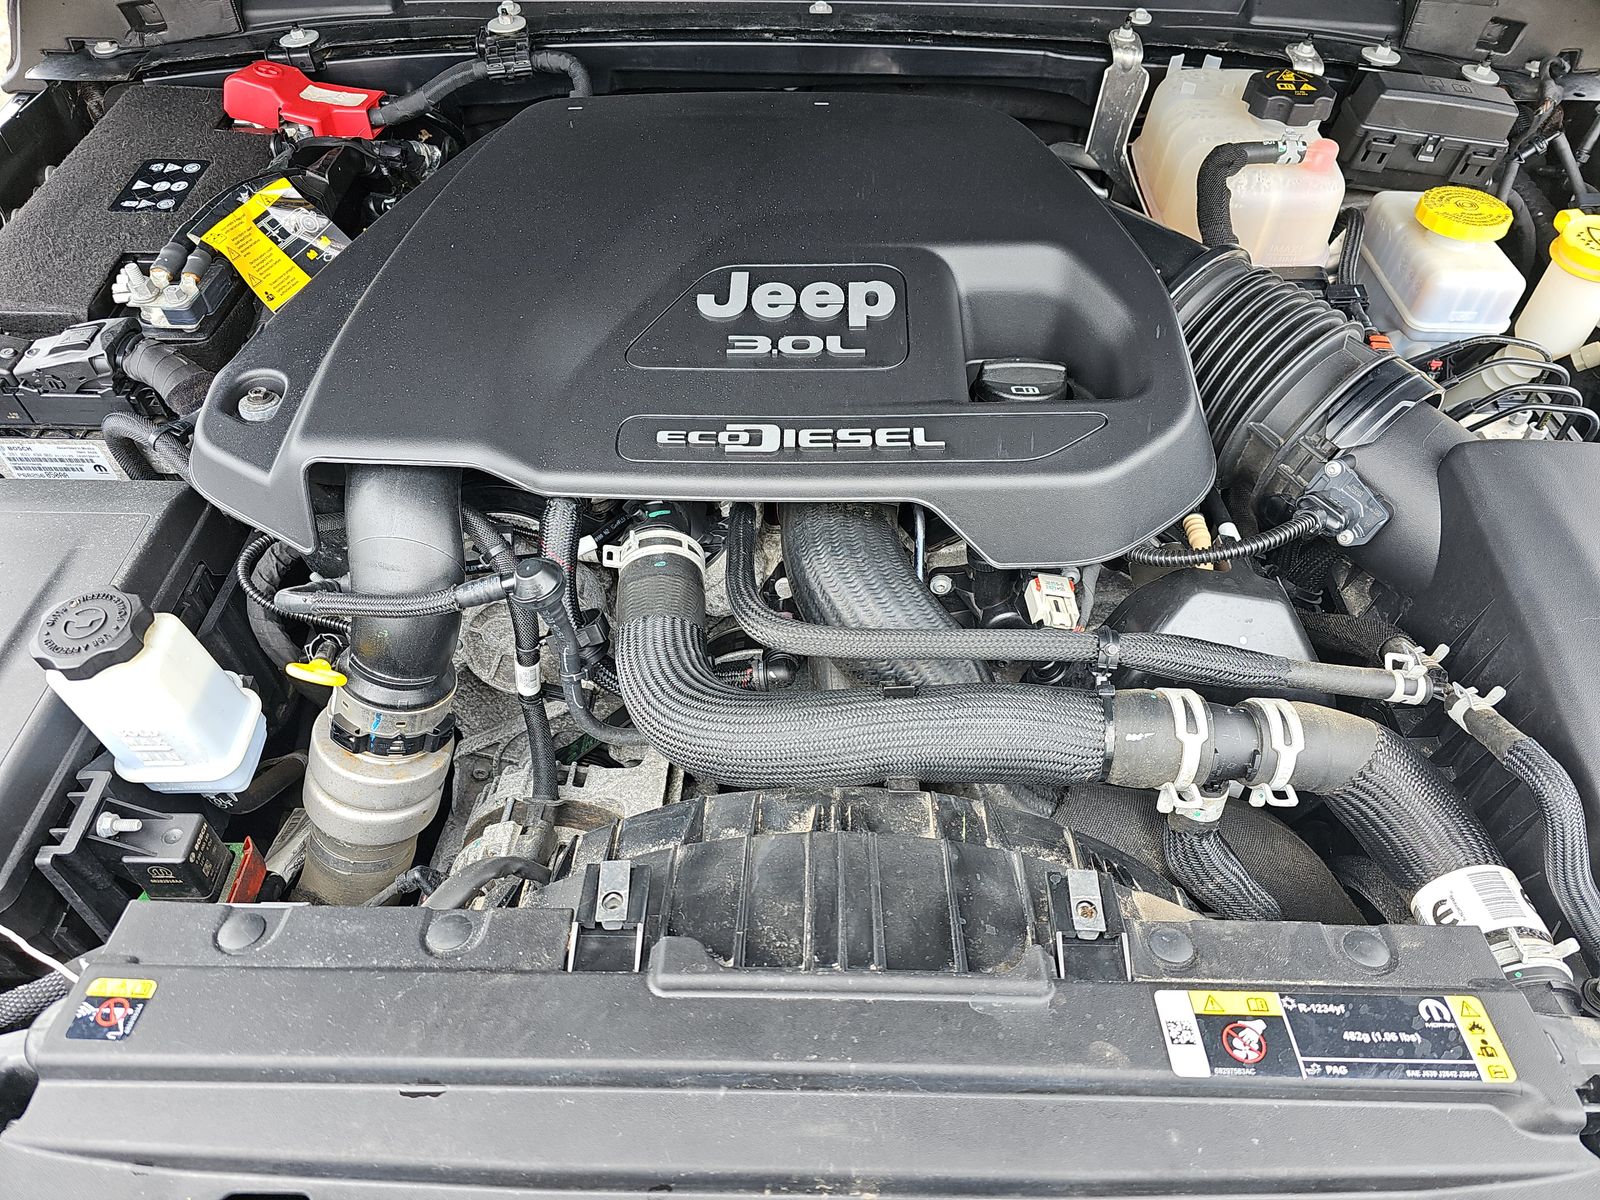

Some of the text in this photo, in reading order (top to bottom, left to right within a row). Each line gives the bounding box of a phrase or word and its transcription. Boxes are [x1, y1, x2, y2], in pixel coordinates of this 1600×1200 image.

[697, 272, 896, 330] Jeep
[726, 335, 866, 358] 3.0L
[43, 638, 90, 654] APPROVED
[194, 822, 208, 851] BOSCH
[1297, 1003, 1346, 1016] R-1234yf
[1343, 1030, 1371, 1044] 482g
[1400, 1031, 1422, 1044] lbs)
[1325, 1065, 1349, 1076] PAG
